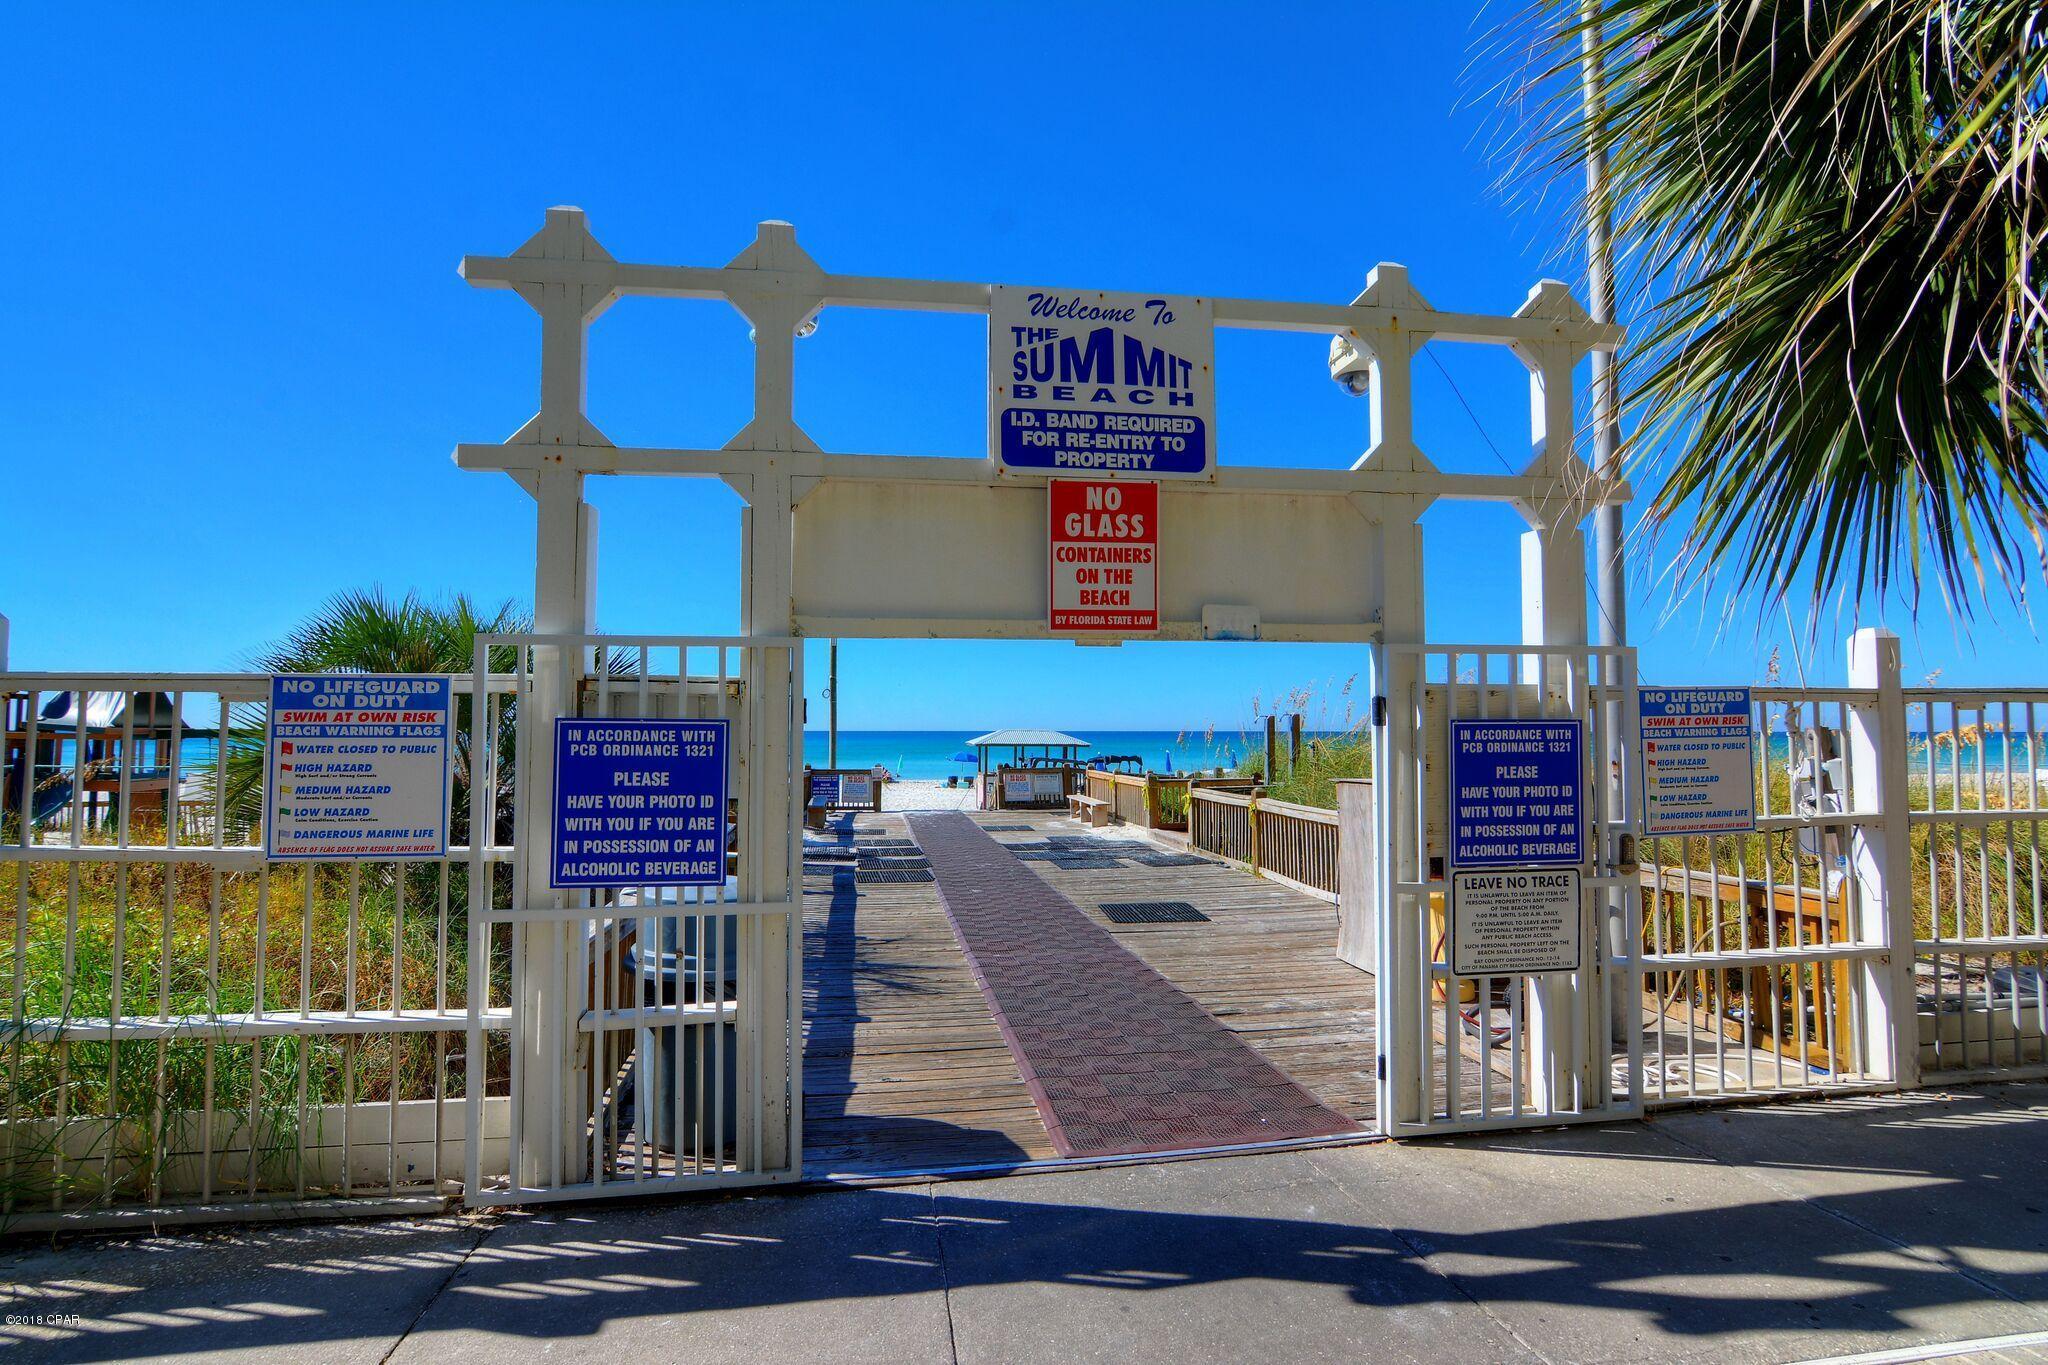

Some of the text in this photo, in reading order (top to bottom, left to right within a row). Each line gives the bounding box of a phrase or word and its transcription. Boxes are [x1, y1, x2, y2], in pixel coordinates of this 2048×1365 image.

[1027, 293, 1176, 326] Welcome To
[1011, 326, 1059, 347] THE
[1013, 327, 1192, 389] SUMMIT
[1013, 384, 1194, 406] BEACH
[1011, 411, 1196, 433] I.D. BAND REQUIRED
[1022, 431, 1185, 451] FOR RE-ENTRY TO
[1055, 451, 1155, 469] PROPERTY
[1086, 487, 1122, 510] NO
[1065, 513, 1144, 537] GLASS
[1056, 547, 1152, 563] CONTAINERS
[1076, 568, 1132, 584] ON THE
[1080, 590, 1130, 605] BEACH
[1055, 616, 1153, 625] BY FLORIDA STATE LAW
[282, 681, 440, 694] NO LIFEGUARD
[312, 695, 410, 708] ON DUTY
[1645, 692, 1744, 702] NO LIFEGUARD
[1665, 703, 1726, 714] ON DUTY
[283, 712, 437, 722] SWIM AT OWN RISK
[1647, 716, 1744, 726] SWIM AT OWN RISK
[276, 726, 441, 736] BEACH WARNING FLAGS
[568, 730, 715, 742] IN ACCORDANCE WITH
[1460, 729, 1571, 740] IN ACCORDANCE WITH
[1644, 728, 1748, 737] BEACH WARNING FLAGS
[296, 745, 437, 754] WATER CLOSED TO PUBLIC
[571, 744, 713, 757] PCB ORDINANCE 1321
[1462, 742, 1570, 753] PCB ORDINANCE 1321
[294, 764, 372, 772] HIGH HAZARD
[1496, 766, 1538, 778] PLEASE
[614, 772, 669, 786] PLEASE
[295, 786, 391, 794] MEDIUM HAZARD
[1461, 785, 1572, 798] HAVE YOUR PHOTO ID
[567, 795, 714, 808] HAVE YOUR PHOTO ID
[294, 808, 370, 817] LOW HAZARD
[1461, 804, 1574, 818] WITH YOU IF YOU ARE
[1660, 811, 1703, 820] DANGEROUS
[1706, 810, 1732, 818] MARINE
[565, 817, 715, 831] WITH YOU IF YOU ARE
[1460, 824, 1574, 837] IN POSSESSION OF AN
[293, 830, 434, 839] DANGEROUS MARINE LIFE
[564, 839, 715, 853] IN POSSESSION OF AN
[1459, 843, 1576, 857] ALCOHOLIC BEVERAGE
[561, 861, 716, 876] ALCOHOLIC BEVERAGE
[1464, 875, 1569, 890] LEAVE NO TRACE
